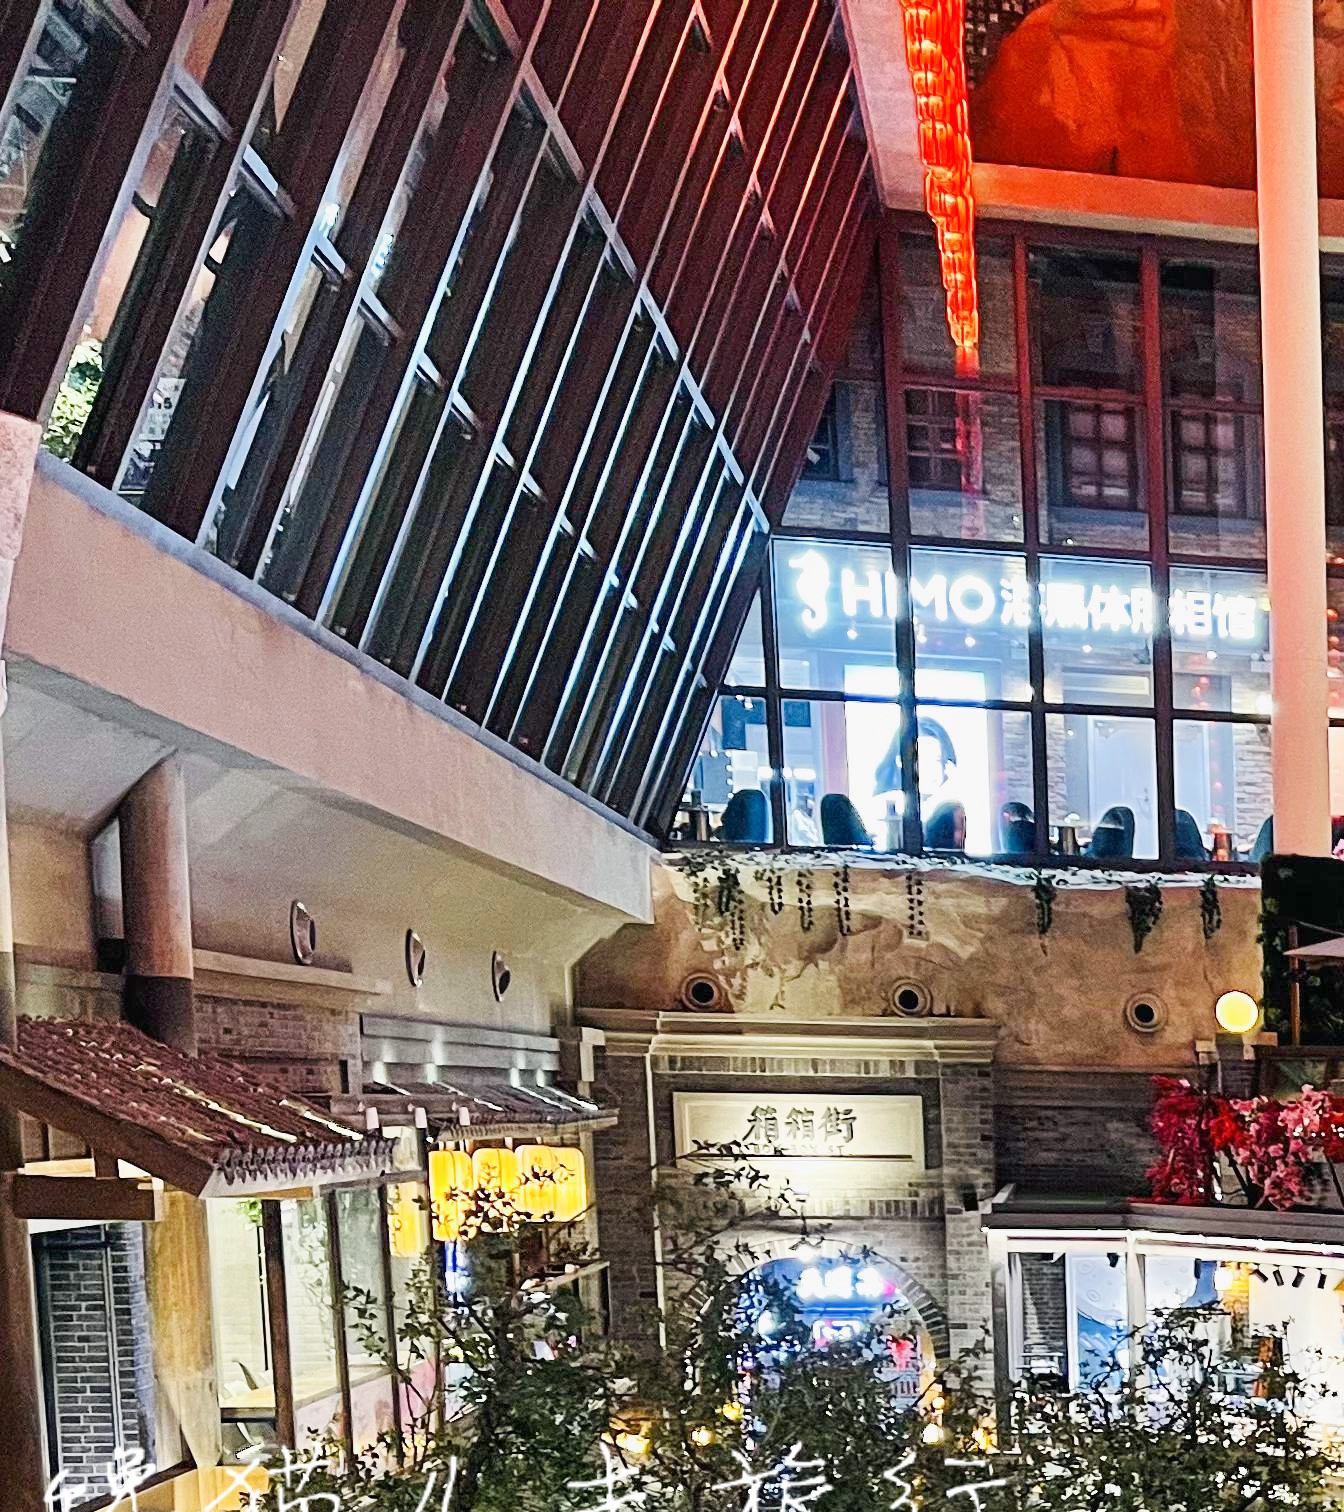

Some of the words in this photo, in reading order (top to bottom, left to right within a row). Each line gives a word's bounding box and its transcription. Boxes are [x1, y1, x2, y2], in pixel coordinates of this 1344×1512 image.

[840, 568, 996, 625] HIMO
[742, 1105, 857, 1142] 箱箱街
